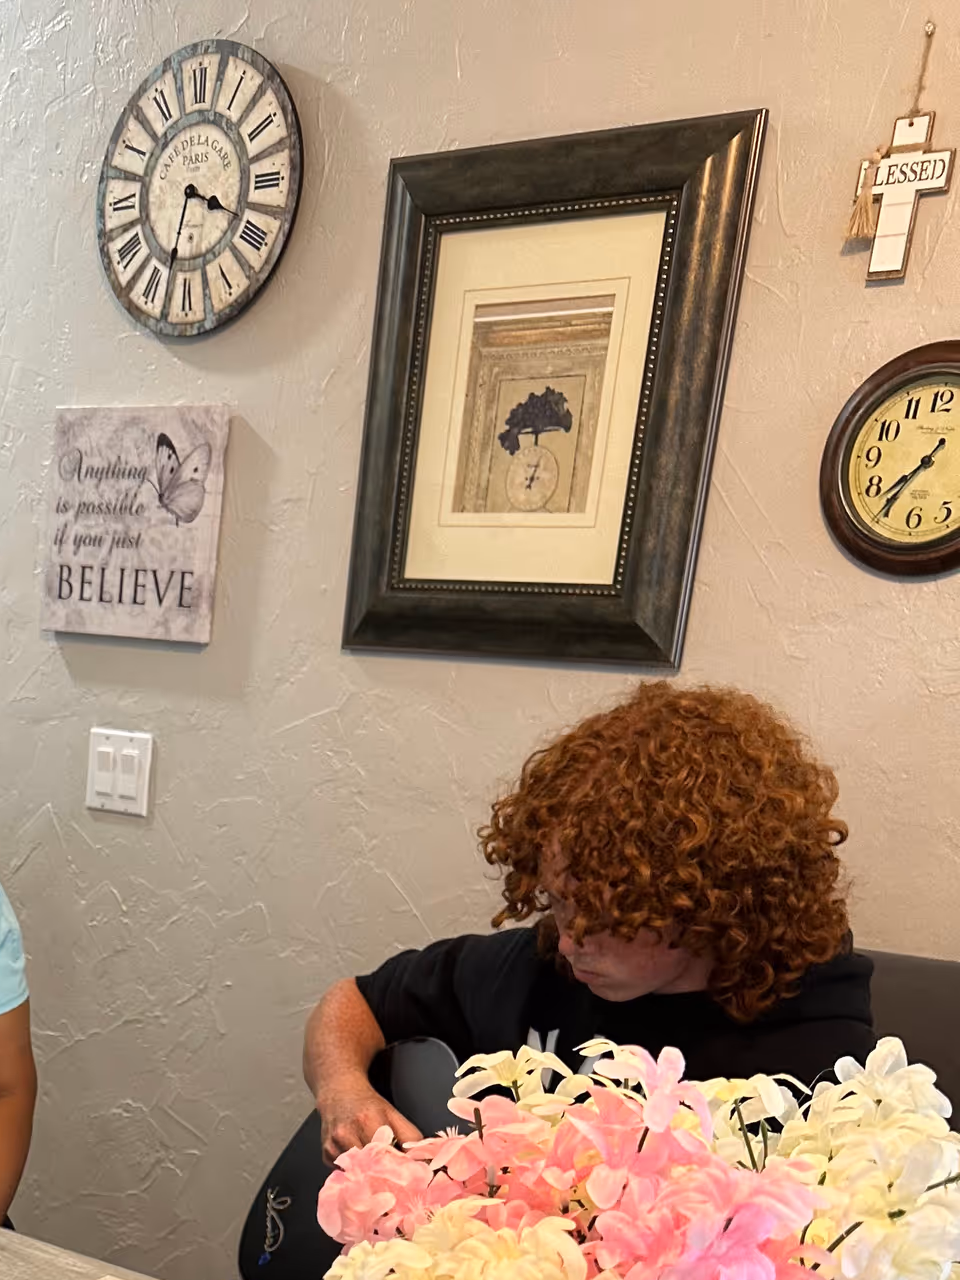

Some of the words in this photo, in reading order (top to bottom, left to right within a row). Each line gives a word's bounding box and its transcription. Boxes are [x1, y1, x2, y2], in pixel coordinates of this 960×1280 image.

[181, 136, 196, 151] DE
[197, 134, 209, 147] LA
[211, 140, 232, 171] GARE
[183, 152, 209, 166] PARIS
[861, 158, 946, 188] LESSED
[904, 397, 922, 420] 11
[929, 389, 955, 413] 12
[877, 419, 901, 443] 10
[58, 448, 148, 483] Anything
[865, 446, 882, 469] 9
[865, 475, 883, 498] 8
[56, 496, 69, 515] is
[75, 492, 146, 523] possible
[905, 506, 923, 529] 6
[934, 501, 953, 524] 5
[54, 522, 70, 554] if
[72, 533, 105, 556] you
[108, 532, 143, 557] just
[57, 564, 195, 609] BELIEVE
